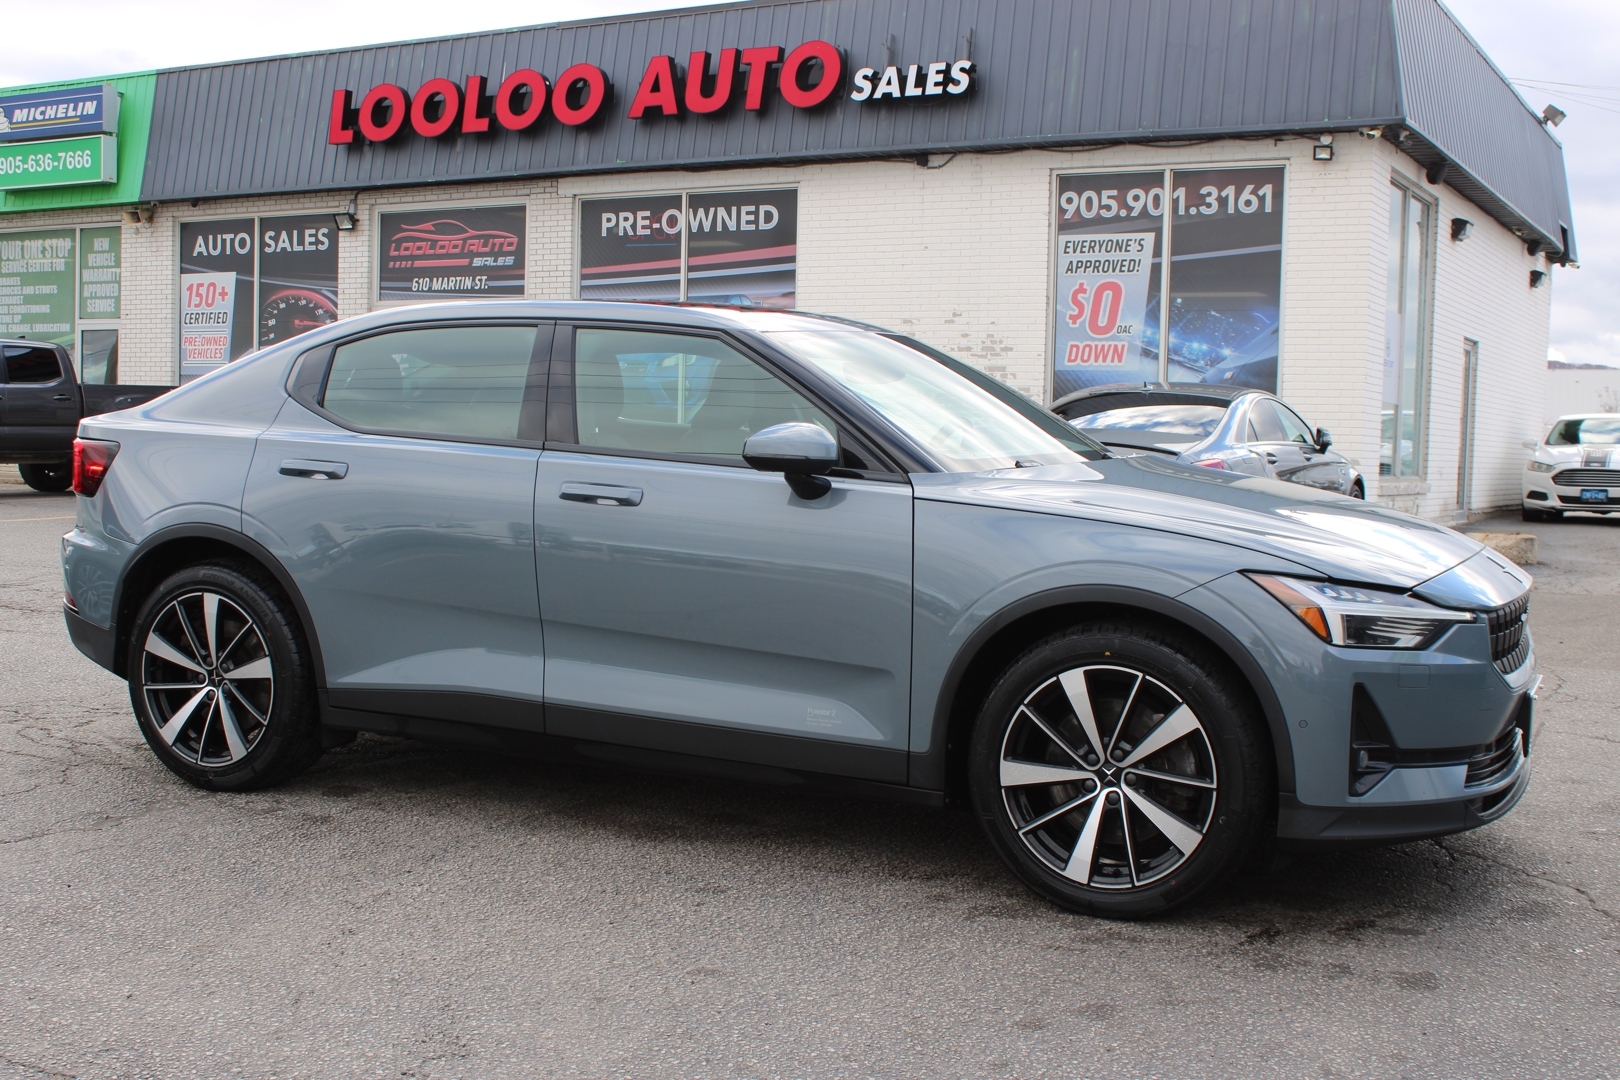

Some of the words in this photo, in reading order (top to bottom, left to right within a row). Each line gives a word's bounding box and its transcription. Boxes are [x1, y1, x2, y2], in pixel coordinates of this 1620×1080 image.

[328, 63, 605, 145] LOOLOO
[627, 40, 842, 119] AUTO
[850, 60, 973, 101] SALES
[13, 101, 97, 122] MICHELIN
[0, 150, 91, 175] 905-636-7666
[1060, 184, 1273, 219] 905.901.3161
[601, 204, 779, 237] PRE-OWNED
[24, 239, 43, 259] ONE
[45, 238, 71, 258] STOP
[94, 238, 110, 251] NEW
[192, 232, 251, 257] AUTO
[264, 228, 329, 253] SALES
[389, 240, 463, 256] LOOLOO
[464, 237, 518, 254] AUTO
[1063, 238, 1145, 254] EVERYONE'S
[1, 260, 28, 274] SERVICE
[28, 259, 52, 273] CENTRE
[53, 259, 65, 272] FOR
[88, 253, 115, 267] VEHICLE
[472, 256, 515, 267] SALES
[1065, 258, 1141, 275] APPROVED!
[82, 268, 120, 282] WARRANTY
[22, 286, 35, 295] AND
[35, 285, 58, 294] STRUTS
[83, 283, 119, 298] APPROVED
[411, 277, 430, 292] 610
[431, 276, 473, 291] MARTIN
[474, 275, 489, 290] ST.
[185, 282, 229, 309] 150+
[9, 304, 50, 314] CONDITIONING
[87, 298, 115, 313] SERVICE
[1068, 281, 1123, 336] $0
[1116, 325, 1133, 335] OAC
[13, 315, 22, 323] UP
[183, 311, 228, 325] CERTIFIED
[32, 323, 70, 332] LUBRICATION
[183, 335, 228, 348] PRE-OWNED
[187, 347, 223, 360] VEHICLES
[1067, 344, 1125, 364] DOWN
[831, 709, 836, 717] 2
